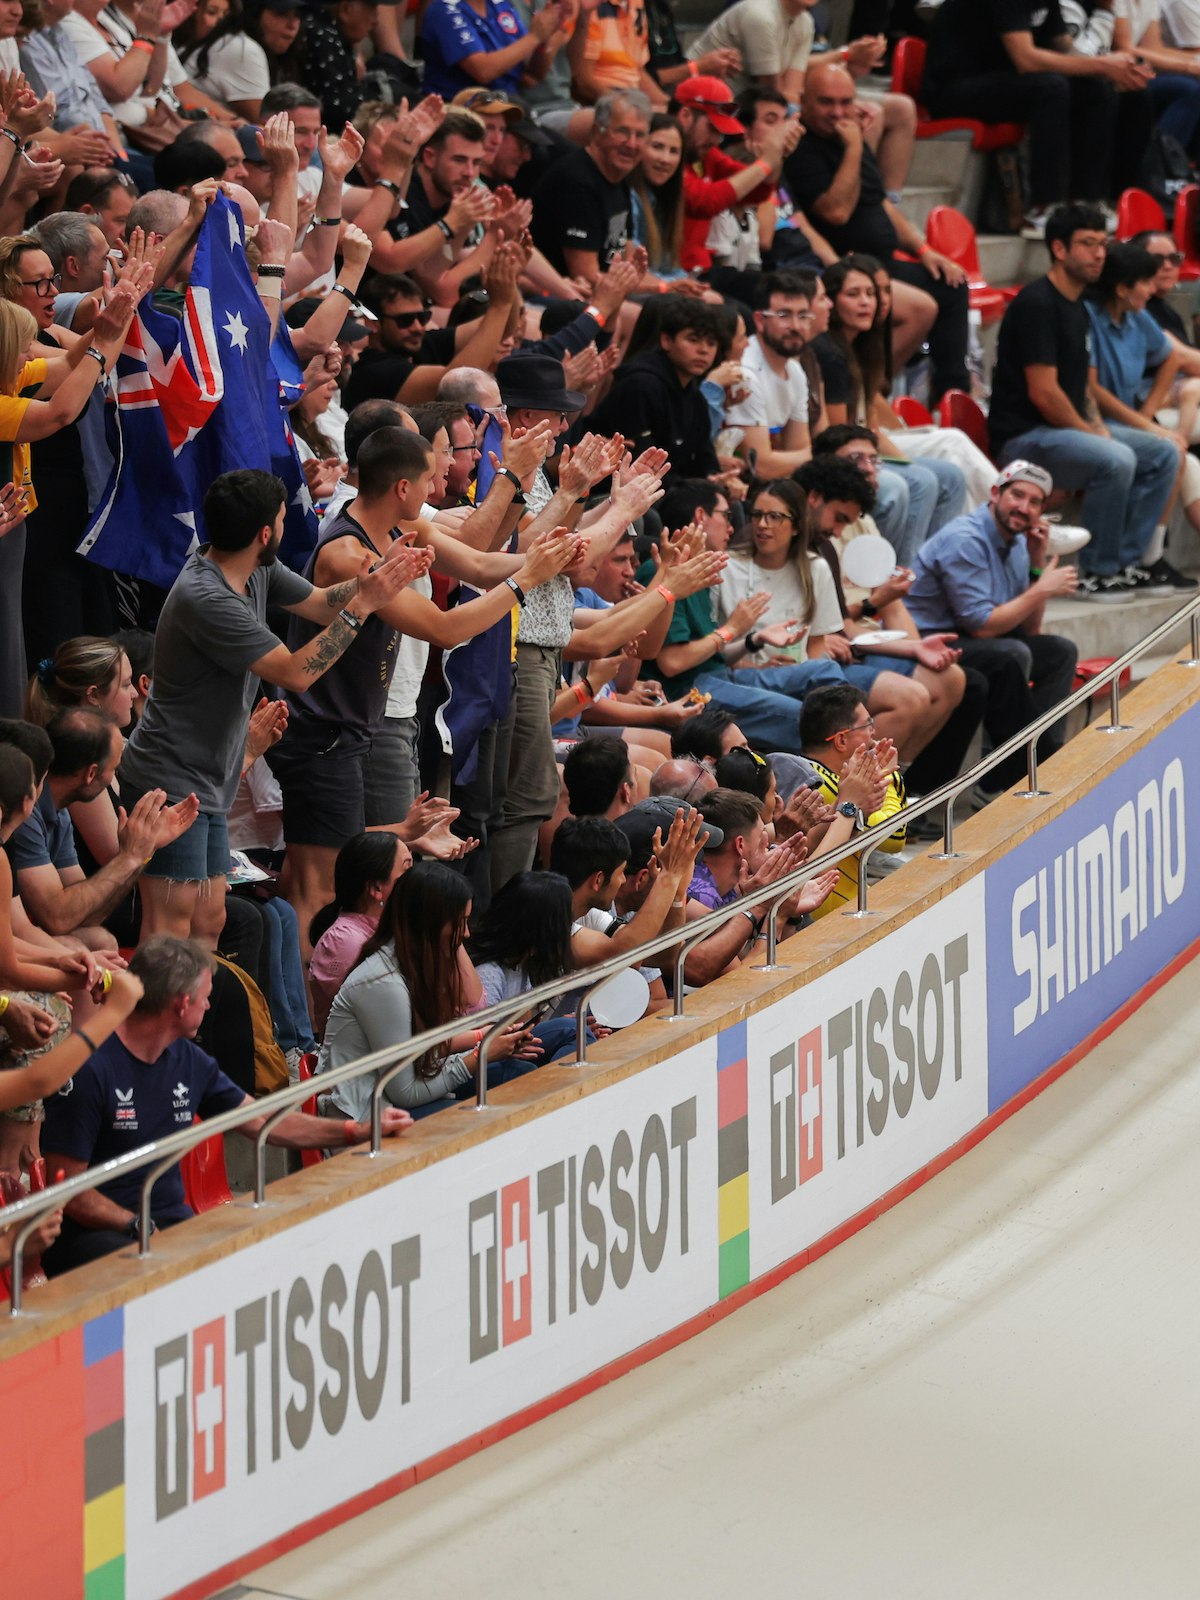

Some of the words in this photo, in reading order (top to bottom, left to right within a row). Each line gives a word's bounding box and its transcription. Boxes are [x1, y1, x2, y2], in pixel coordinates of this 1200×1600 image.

[1010, 755, 1189, 1038] SHIMANO
[828, 932, 969, 1161] TISSOT
[537, 1095, 697, 1326] TISSOT
[235, 1234, 421, 1476] TISSOT
